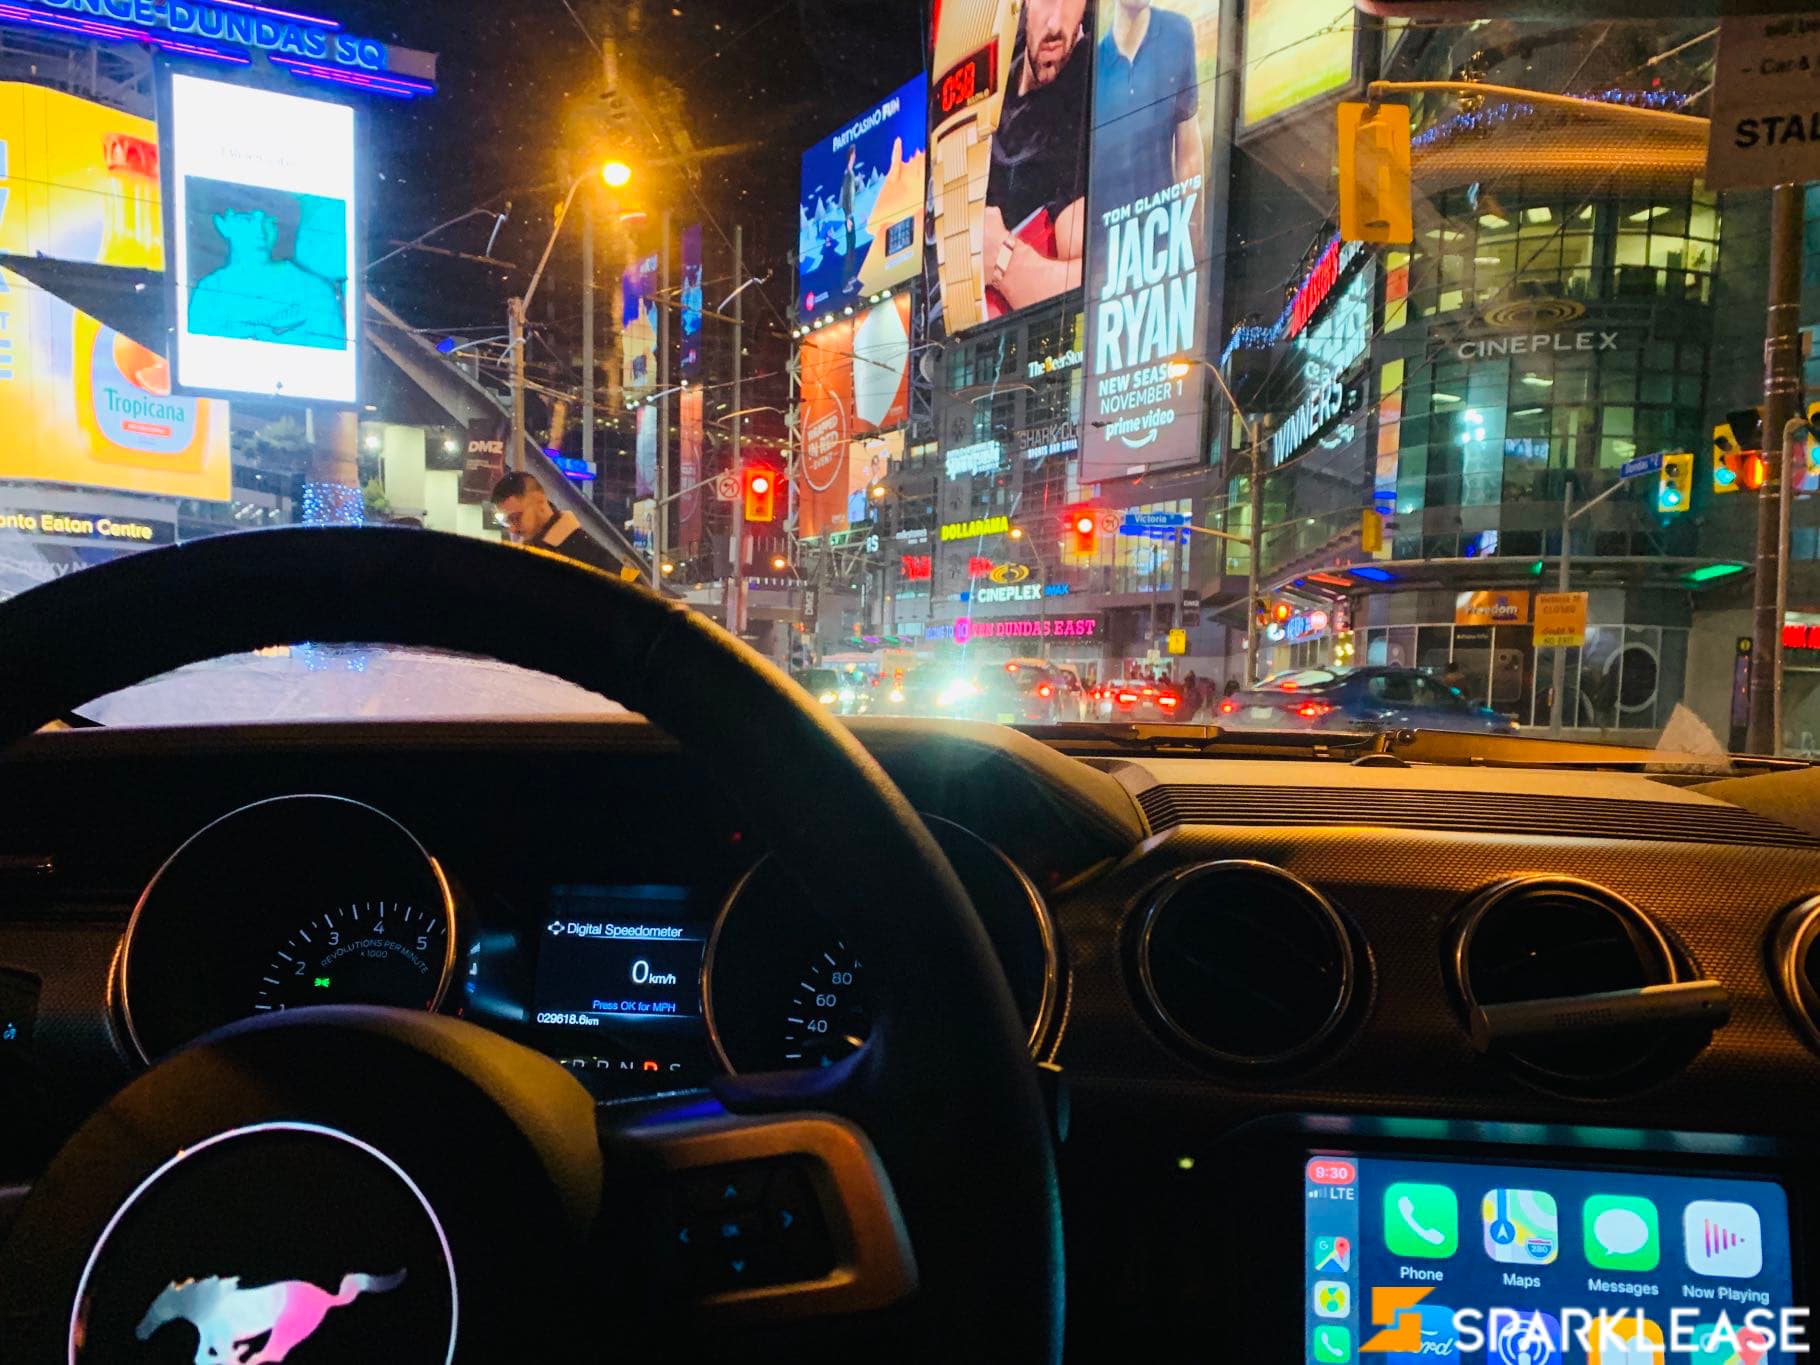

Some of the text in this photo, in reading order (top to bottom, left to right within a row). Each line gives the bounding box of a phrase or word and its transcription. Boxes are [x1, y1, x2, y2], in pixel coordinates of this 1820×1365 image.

[335, 33, 388, 70] SQ
[881, 96, 900, 121] FUN
[1102, 174, 1202, 227] TOM CLANCY'S
[1101, 192, 1198, 301] JACK
[1095, 272, 1198, 375] RYAN
[1457, 332, 1618, 360] CINEPLEX
[1098, 373, 1131, 398] NEW
[103, 386, 185, 423] Tropicana
[1100, 378, 1183, 416] NOVEMBER 1
[1105, 408, 1175, 442] prime video
[1273, 364, 1344, 468] WINNERS
[1019, 423, 1058, 450] SHARK
[468, 440, 504, 454] DMZ
[41, 515, 93, 533] Eaton
[97, 518, 153, 539] Centre
[1134, 513, 1168, 524] Victoria
[940, 516, 1008, 541] DOLLARAMA
[977, 584, 1041, 602] CINEPLEX
[997, 619, 1050, 639] DUNDAS
[1054, 619, 1096, 637] EAST
[373, 921, 384, 935] 4
[567, 923, 683, 939] Digital Speedometer
[328, 932, 340, 946] 3
[416, 936, 428, 950] 5
[320, 938, 429, 975] REVOLUTIONS PER MINUTE
[367, 950, 389, 959] 1000
[295, 961, 306, 976] 2
[631, 960, 677, 985] 0 km/h
[832, 972, 853, 985] 80
[592, 1000, 677, 1013] Press OK for MPH
[815, 994, 837, 1007] 60
[807, 1019, 828, 1033] 40
[1315, 1166, 1348, 1180] 9:30
[1330, 1187, 1355, 1200] LTE
[1400, 1265, 1443, 1281] Phone
[1503, 1272, 1541, 1289] Maps
[1588, 1278, 1659, 1297] Messages
[1682, 1285, 1770, 1306] Now Playing
